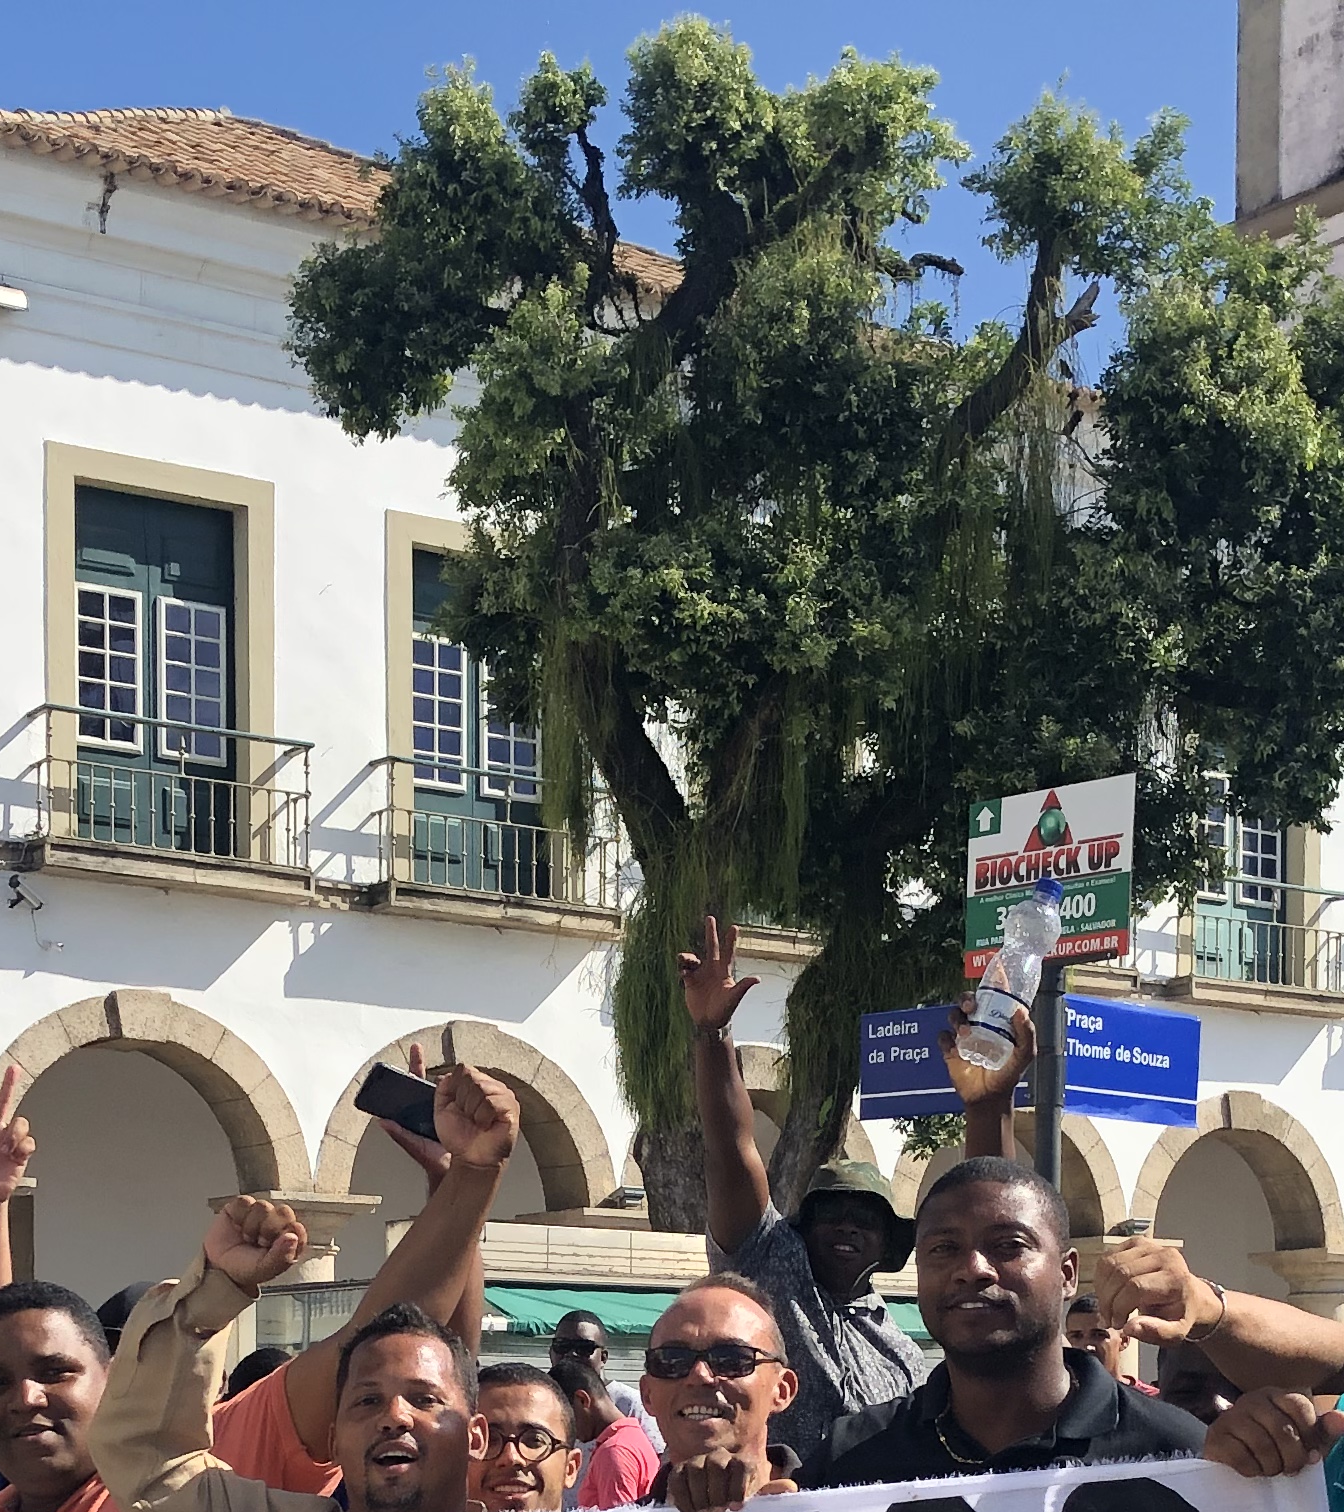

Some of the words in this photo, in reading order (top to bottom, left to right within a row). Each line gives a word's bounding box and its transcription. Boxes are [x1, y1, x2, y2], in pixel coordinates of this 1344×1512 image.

[975, 847, 1081, 891] BIOCHECK
[1088, 840, 1121, 872] UP
[868, 1020, 918, 1039] Ladeira
[1066, 1008, 1103, 1033] Praça
[868, 1049, 885, 1064] da
[890, 1046, 929, 1064] Praça
[1067, 1037, 1111, 1060] Thomé
[1115, 1044, 1131, 1063] de
[1132, 1046, 1170, 1069] Souza
